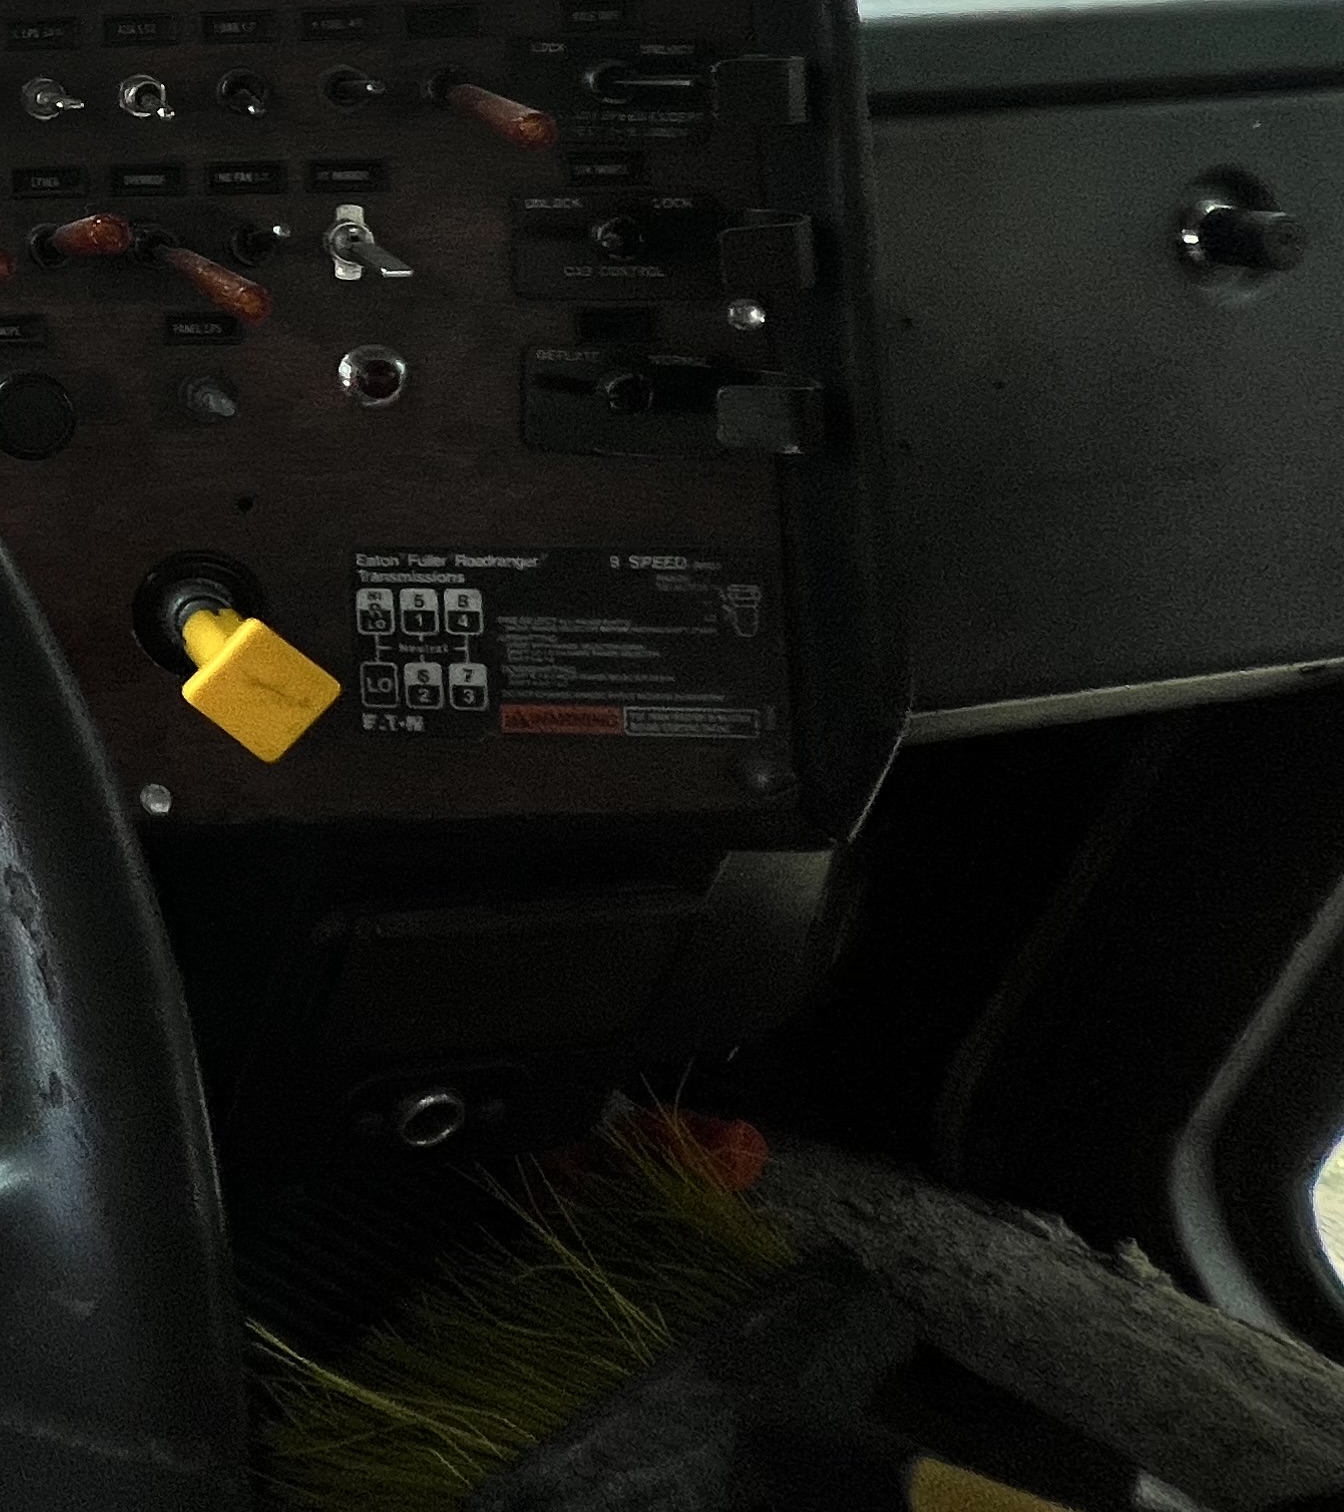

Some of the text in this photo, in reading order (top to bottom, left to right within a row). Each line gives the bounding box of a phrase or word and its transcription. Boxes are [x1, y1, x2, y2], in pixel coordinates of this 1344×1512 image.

[652, 197, 693, 209] LOCK
[599, 266, 665, 278] CONTROL
[355, 553, 539, 570] Eaton Fuller Roadranger
[628, 555, 688, 569] SPEED
[357, 570, 465, 584] Transmissions
[414, 594, 425, 607] 5
[367, 618, 386, 630] LO
[416, 614, 424, 627] 1
[457, 615, 470, 628] 4
[463, 668, 473, 683] 7
[366, 677, 393, 693] LO
[418, 689, 431, 703] 2
[463, 690, 475, 705] 3
